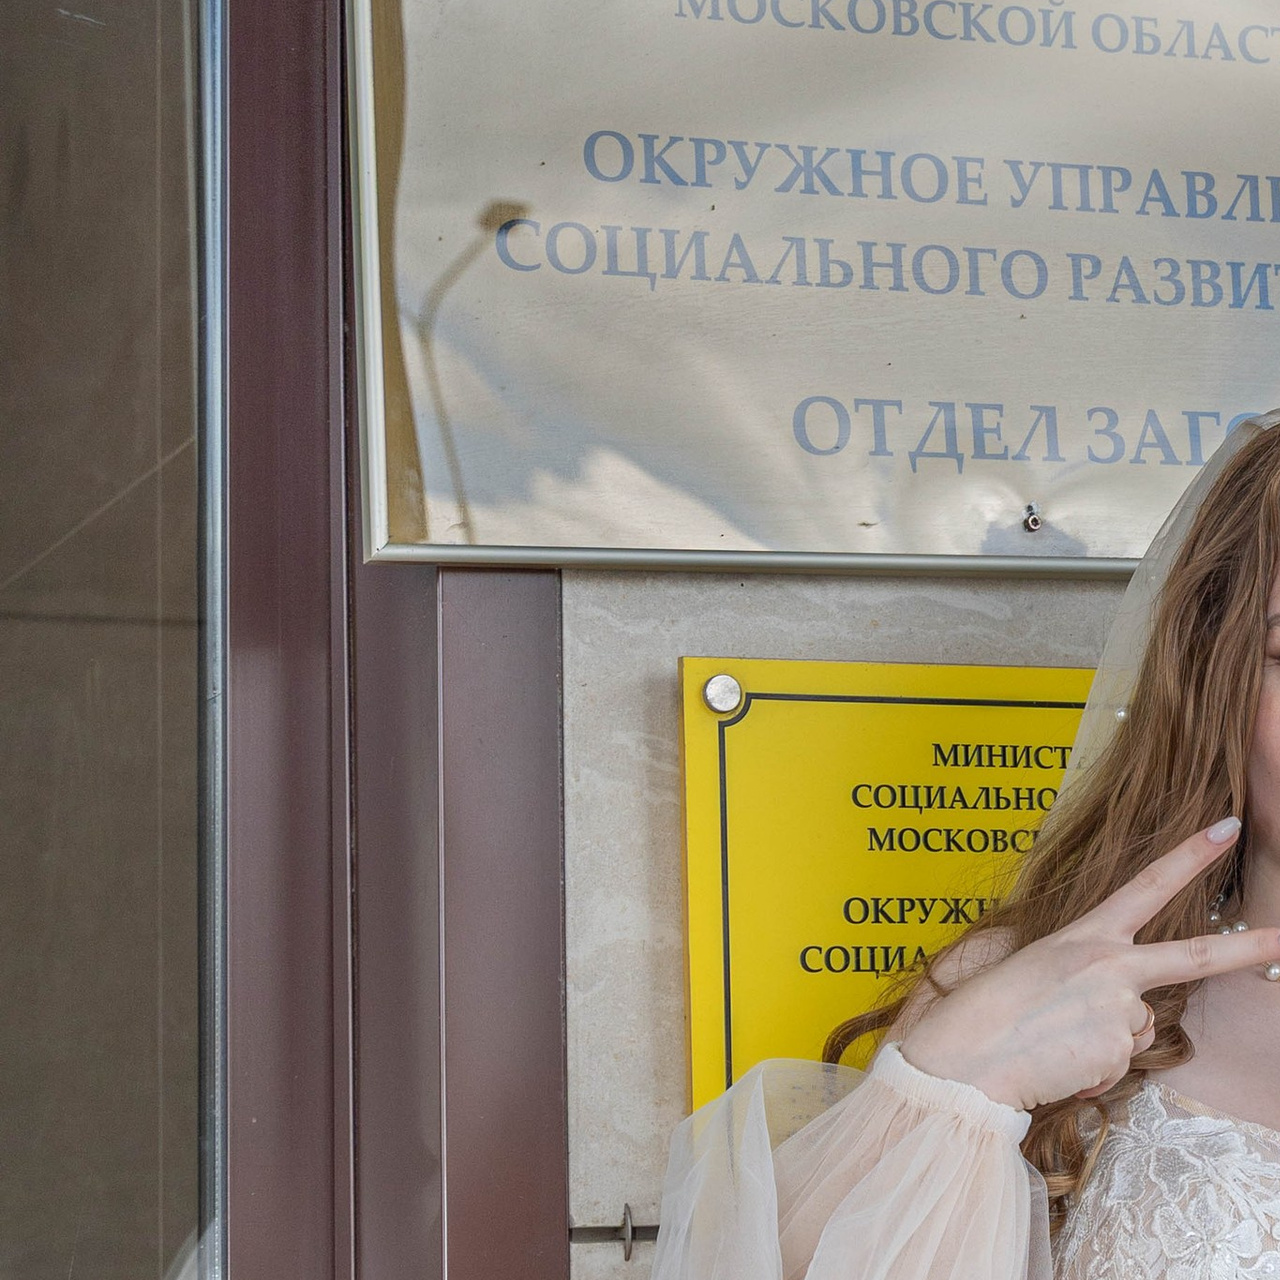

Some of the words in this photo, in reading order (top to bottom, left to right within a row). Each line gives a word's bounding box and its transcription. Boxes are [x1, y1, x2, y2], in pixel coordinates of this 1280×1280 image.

[582, 130, 988, 207] ОКРУЖНОЕ
[495, 219, 1050, 302] СОЦИАЛЬНОГО
[792, 395, 1063, 475] ОТДЕЛ
